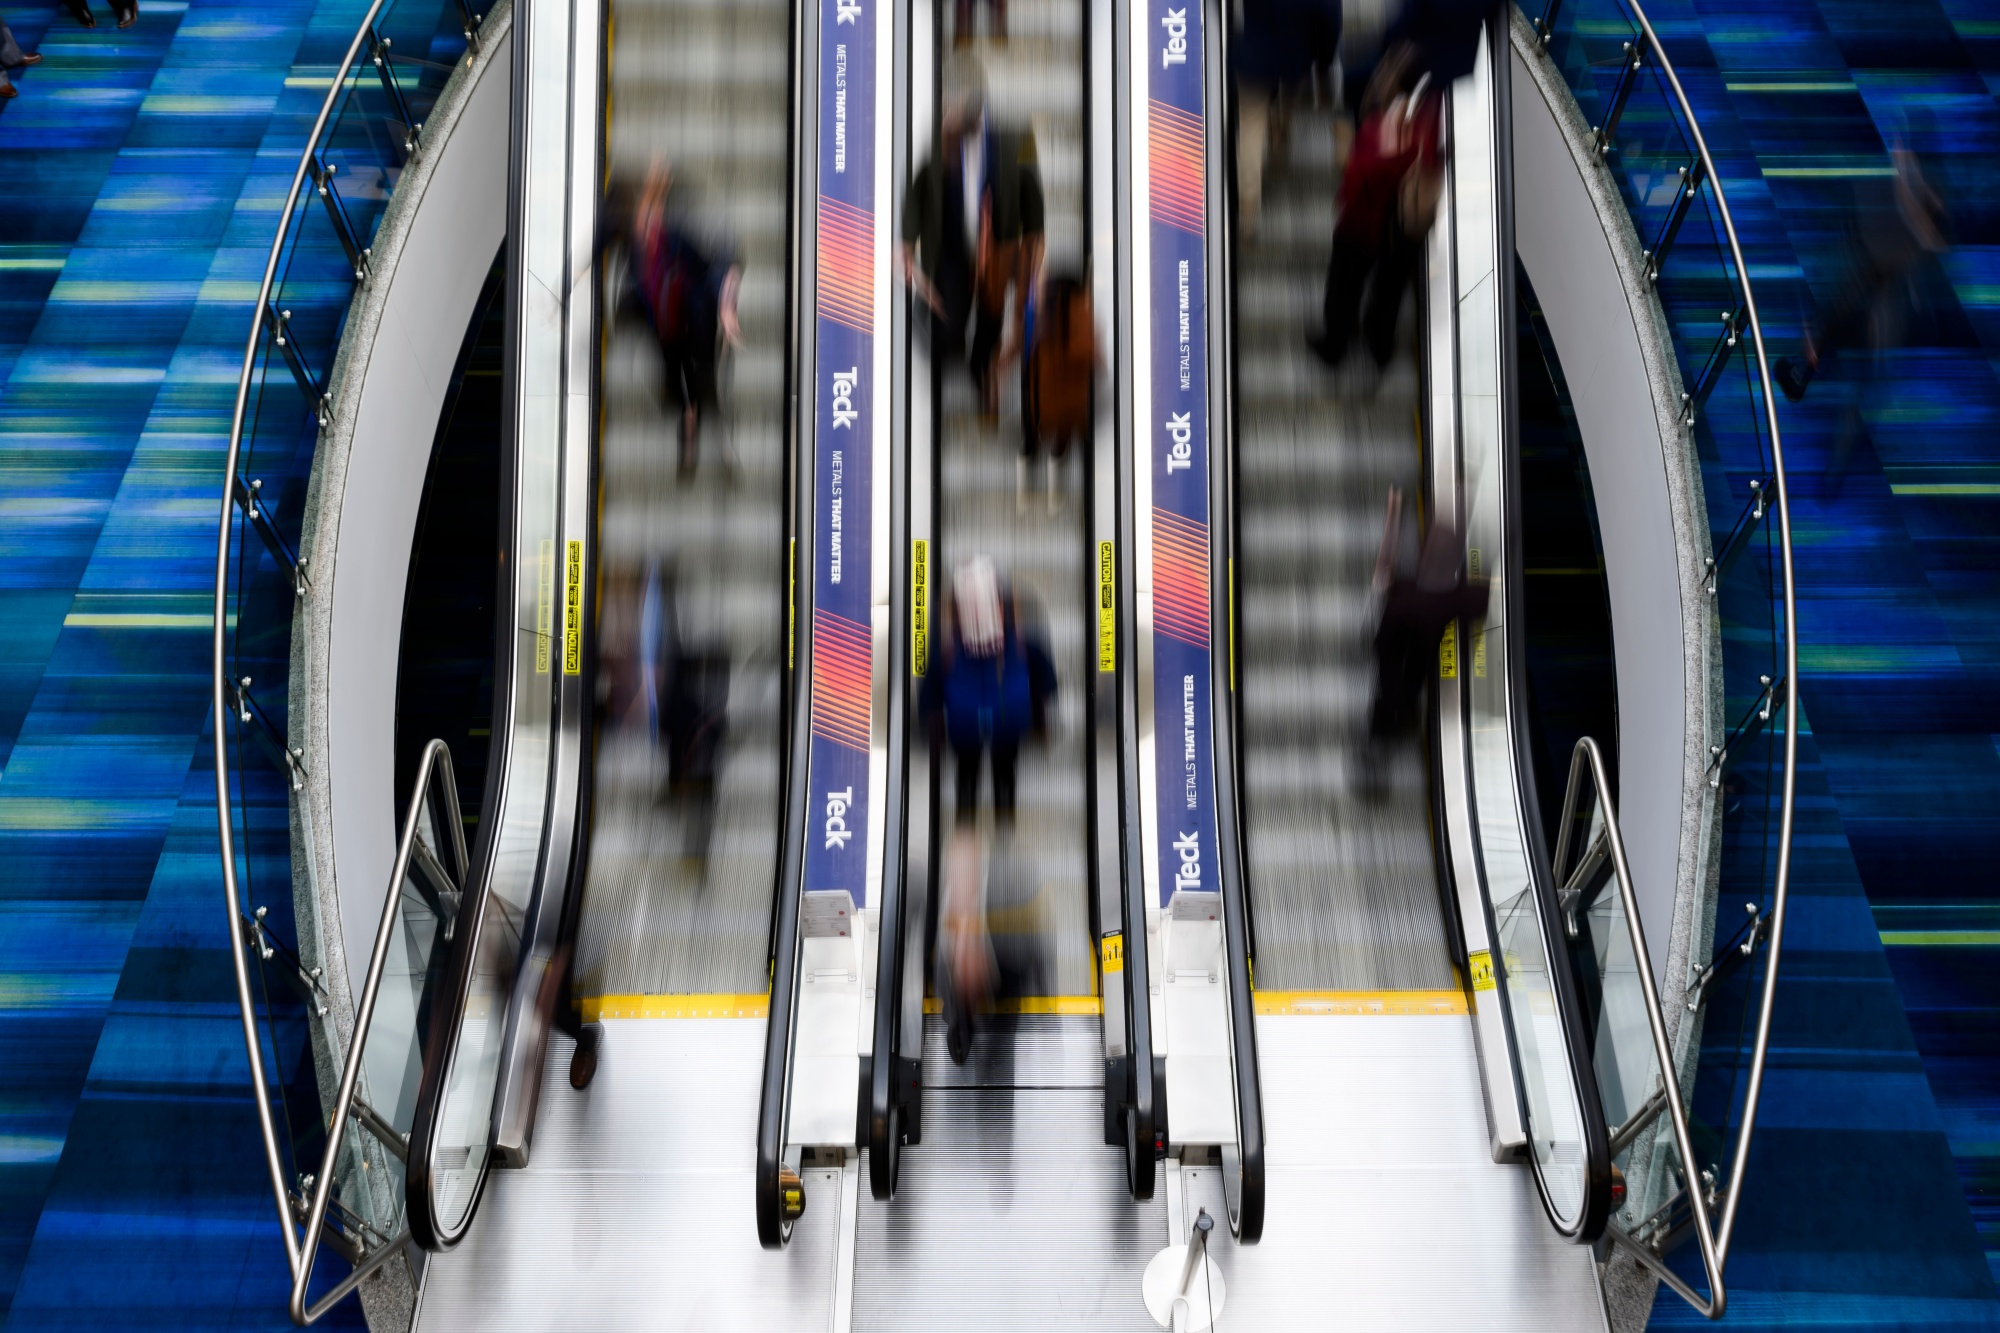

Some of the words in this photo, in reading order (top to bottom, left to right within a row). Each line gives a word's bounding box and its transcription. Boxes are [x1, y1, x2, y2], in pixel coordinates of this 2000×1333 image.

[1162, 7, 1186, 70] Teck
[836, 45, 846, 87] METALS
[836, 88, 846, 122] THAT
[835, 123, 845, 173] MATTER
[1179, 259, 1189, 311] MATTER
[1180, 311, 1190, 343] THAT
[1180, 344, 1190, 391] METALS
[833, 366, 858, 430] Teck
[1165, 411, 1192, 475] Teck
[832, 450, 842, 497] METALS
[831, 497, 842, 529] THAT
[831, 531, 841, 584] MATTER
[1102, 543, 1111, 582] CAUTION
[567, 631, 577, 669] CAUTION
[915, 632, 925, 673] CAUTION
[1184, 674, 1194, 727] MATTER
[1185, 727, 1195, 760] THAT
[1186, 762, 1197, 811] METALS
[825, 786, 852, 851] Teck
[1173, 831, 1201, 891] Teck
